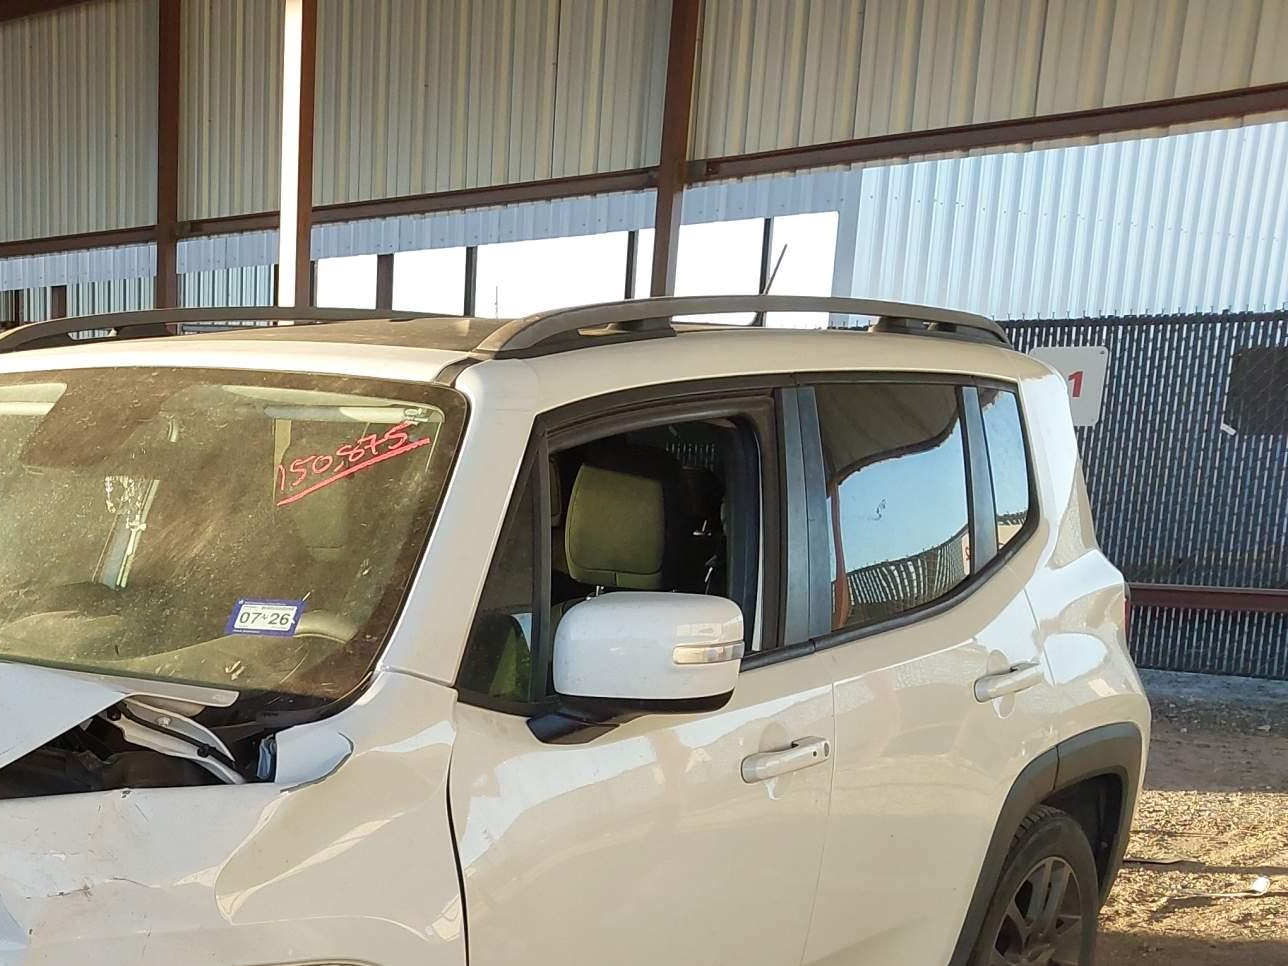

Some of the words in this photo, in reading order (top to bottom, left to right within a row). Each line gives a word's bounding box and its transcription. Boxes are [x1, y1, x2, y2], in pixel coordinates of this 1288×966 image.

[1068, 371, 1083, 397] 1
[239, 611, 262, 625] 07
[268, 612, 291, 626] 26
